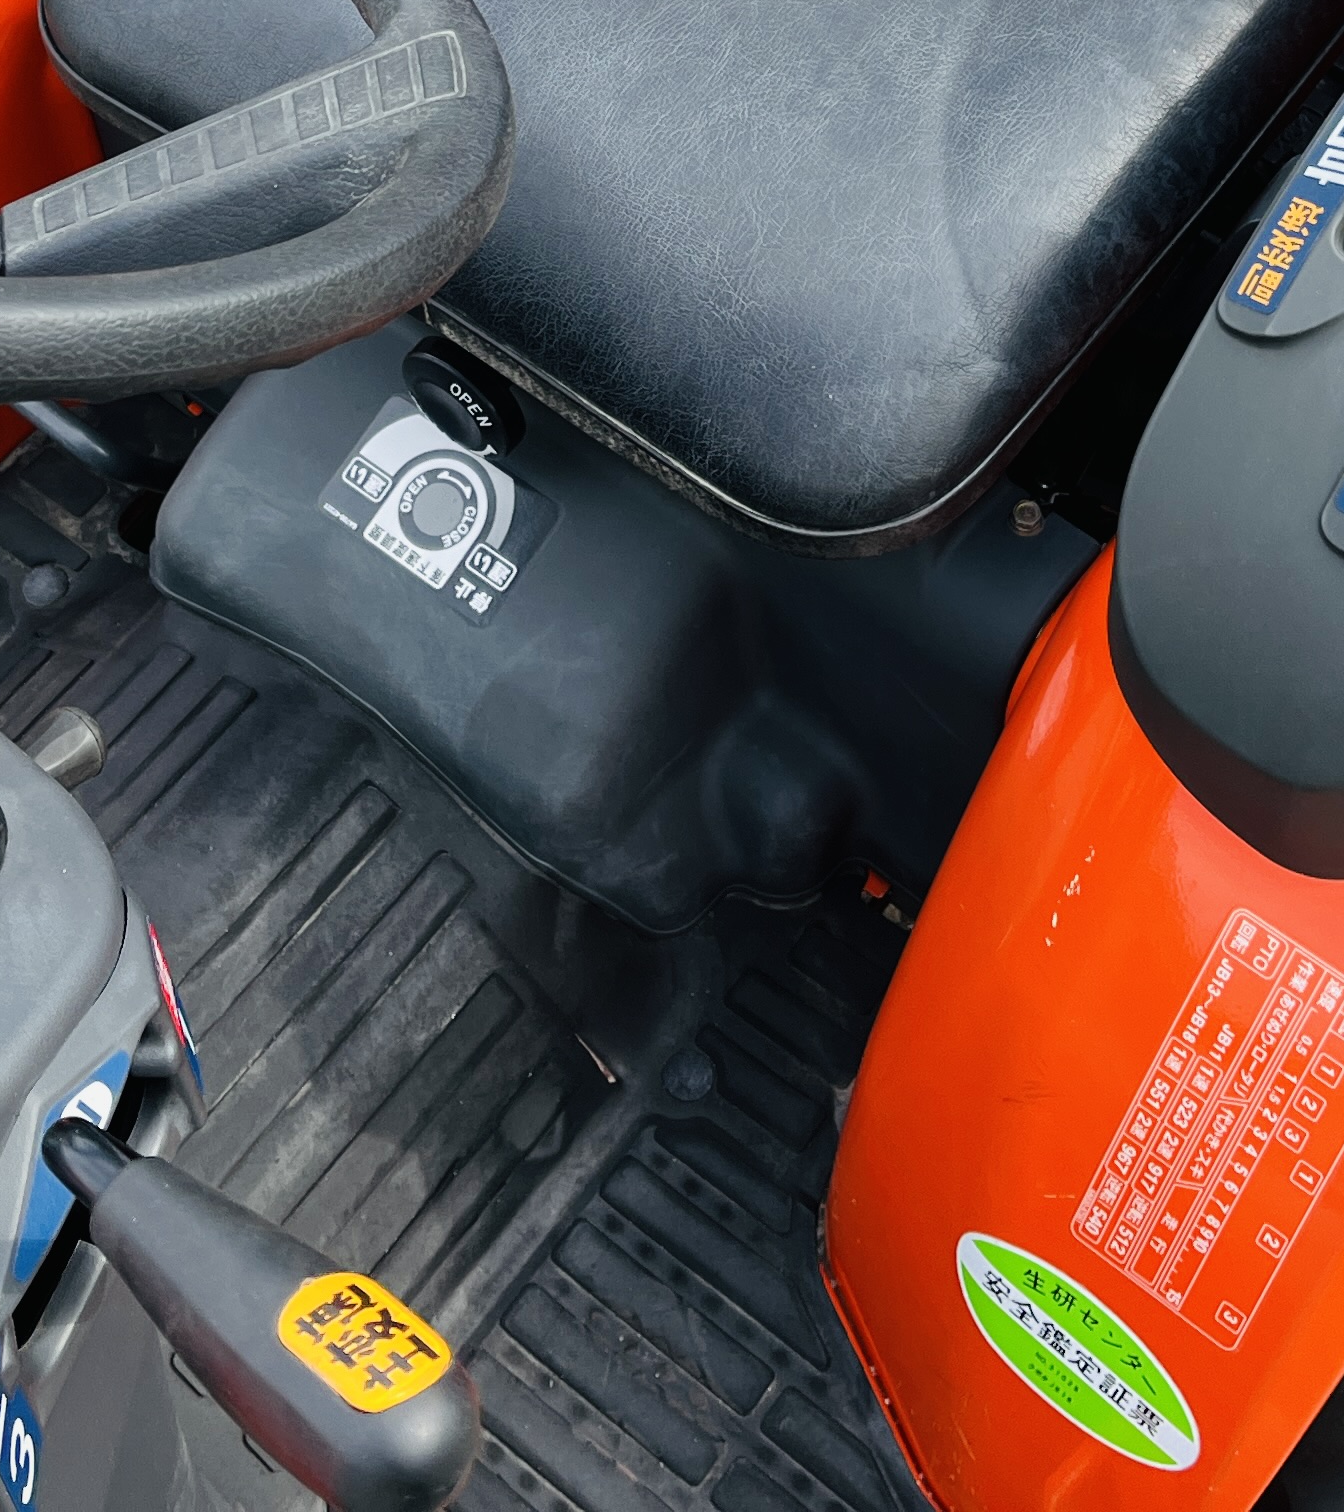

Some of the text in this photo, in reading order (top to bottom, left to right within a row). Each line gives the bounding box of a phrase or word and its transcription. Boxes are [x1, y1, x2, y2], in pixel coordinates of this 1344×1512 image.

[1236, 198, 1325, 306] 副変速
[449, 382, 493, 428] OPEN
[400, 475, 428, 514] OPEN
[441, 506, 477, 549] CLOSE
[454, 577, 493, 614] 停止
[1230, 919, 1256, 952] 回転
[1252, 934, 1280, 971] PTO
[1289, 959, 1314, 992] 作業
[1317, 978, 1344, 1012] 速度
[1209, 1023, 1234, 1061] JB11
[1295, 1034, 1312, 1055] 0.5
[1283, 1072, 1297, 1084] 1
[1320, 1065, 1335, 1077] 1
[1146, 1078, 1170, 1109] 551
[1301, 1095, 1317, 1111] 2
[1172, 1096, 1197, 1128] 523
[1262, 1107, 1278, 1122] 2
[1252, 1126, 1267, 1140] 3
[1284, 1127, 1300, 1142] 3
[1114, 1143, 1136, 1174] 967
[1243, 1143, 1257, 1157] 4
[1140, 1161, 1163, 1194] 917
[1233, 1162, 1248, 1177] 5
[1298, 1171, 1313, 1184] 1
[1223, 1180, 1239, 1194] 6
[1084, 1205, 1107, 1235] 540
[1205, 1214, 1220, 1228] 8
[1215, 1198, 1230, 1214] 7
[1110, 1225, 1134, 1255] 512
[1199, 1226, 1214, 1239] 9
[1262, 1232, 1280, 1248] 2
[1165, 1288, 1181, 1305] 15
[1022, 1267, 1158, 1396] 生研センター
[1222, 1310, 1238, 1324] 3
[296, 1283, 440, 1392] 主変速
[981, 1270, 1164, 1436] 安全鑑定証票
[9, 1417, 35, 1506] 3
